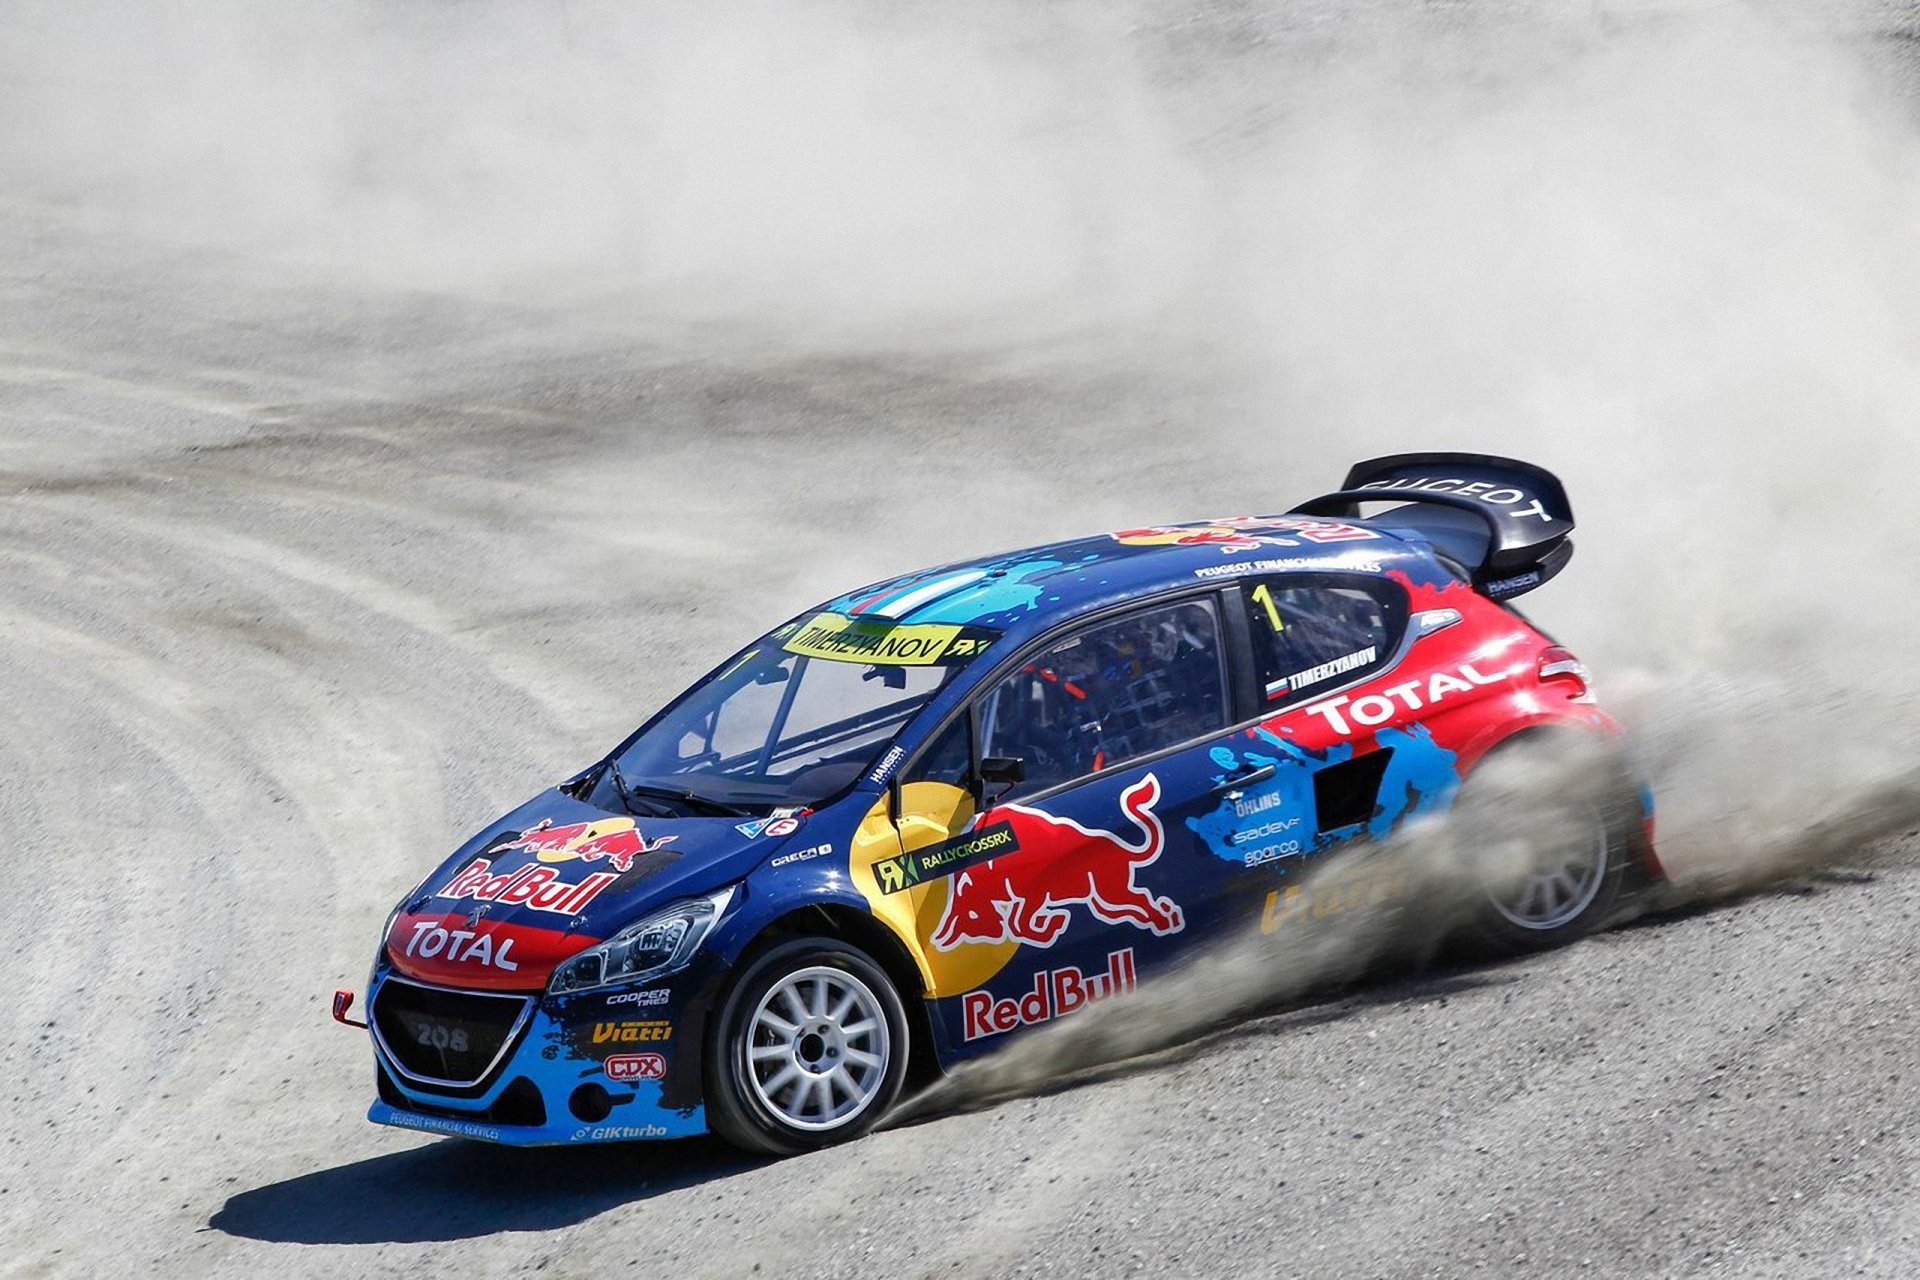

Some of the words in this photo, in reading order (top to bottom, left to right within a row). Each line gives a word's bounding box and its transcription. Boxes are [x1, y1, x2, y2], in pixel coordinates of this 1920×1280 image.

[1357, 478, 1553, 523] EUGEOT
[1194, 561, 1253, 578] PEUGEOT
[1252, 584, 1284, 632] 1
[793, 627, 944, 658] TIMERZYANOV
[1288, 645, 1377, 691] TIMERZYANOV
[1306, 664, 1507, 735] TOTAL
[869, 745, 904, 783] HANSEN
[922, 830, 1012, 870] RALLYCROSSRX
[1244, 840, 1299, 866] sparco
[405, 920, 520, 972] TOTAL
[606, 988, 671, 1005] COOPER
[637, 997, 670, 1007] TIRES
[417, 1022, 469, 1053] 208
[592, 1021, 673, 1044] Viatti
[610, 1057, 662, 1077] CDX
[389, 1112, 424, 1128] PEUGEOT
[424, 1117, 462, 1134] FINANCIAL
[464, 1122, 500, 1140] SERVICES
